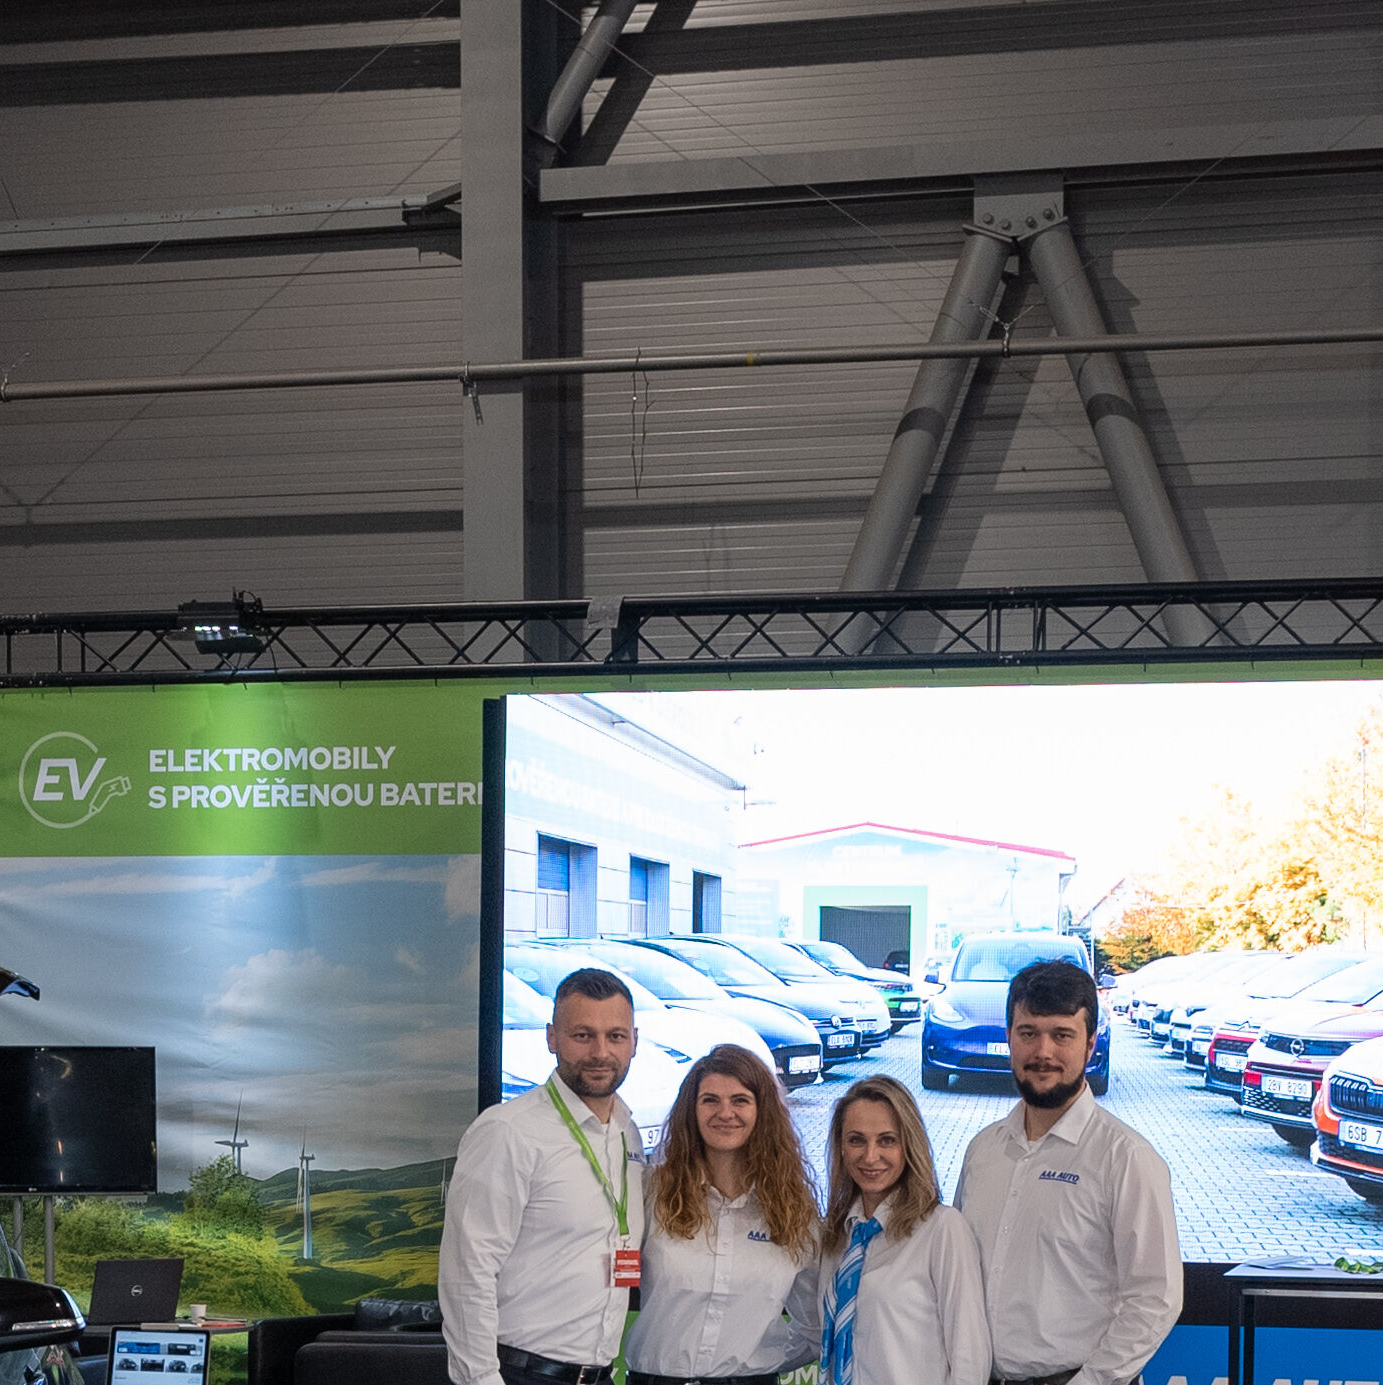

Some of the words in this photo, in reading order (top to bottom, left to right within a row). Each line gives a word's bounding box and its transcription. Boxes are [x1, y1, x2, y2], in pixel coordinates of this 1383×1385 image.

[148, 746, 396, 773] ELEKTROMOBILY
[33, 757, 107, 801] EV
[148, 785, 166, 809] S
[171, 777, 374, 809] PROVĚŘENOU
[1347, 1125, 1367, 1143] 6SB
[748, 1230, 766, 1240] AAA
